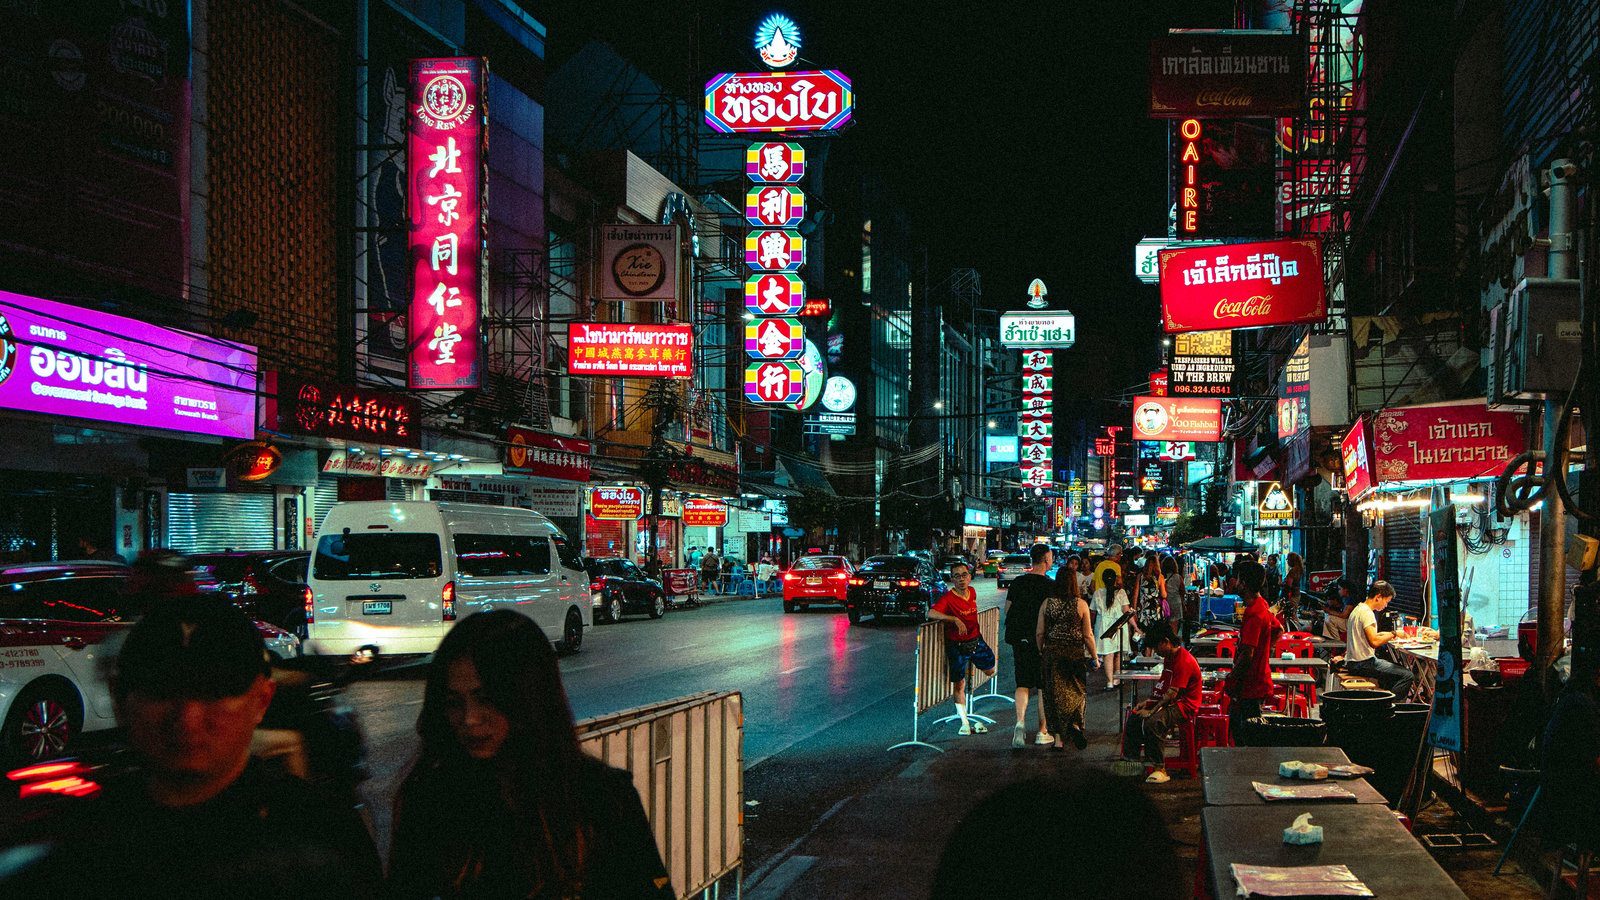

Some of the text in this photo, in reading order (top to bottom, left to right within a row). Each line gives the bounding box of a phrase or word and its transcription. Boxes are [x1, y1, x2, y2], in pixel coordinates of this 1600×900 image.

[722, 80, 837, 123] ทองใบ
[435, 120, 456, 130] REN
[427, 136, 463, 366] 北京同仁堂
[760, 145, 790, 399] 馬利興大金行
[1213, 295, 1273, 319] Coca-Cola
[30, 325, 67, 341] ธนาคาร
[30, 346, 148, 393] ออมสิน
[1174, 372, 1232, 382] IN THE BREW
[31, 381, 148, 410] Government Savings Bank
[1174, 385, 1231, 394] 096.324.6541
[1190, 420, 1218, 428] Fishball
[1429, 417, 1493, 440] เจ้าแรก
[1408, 440, 1509, 464] ในเยาวราช
